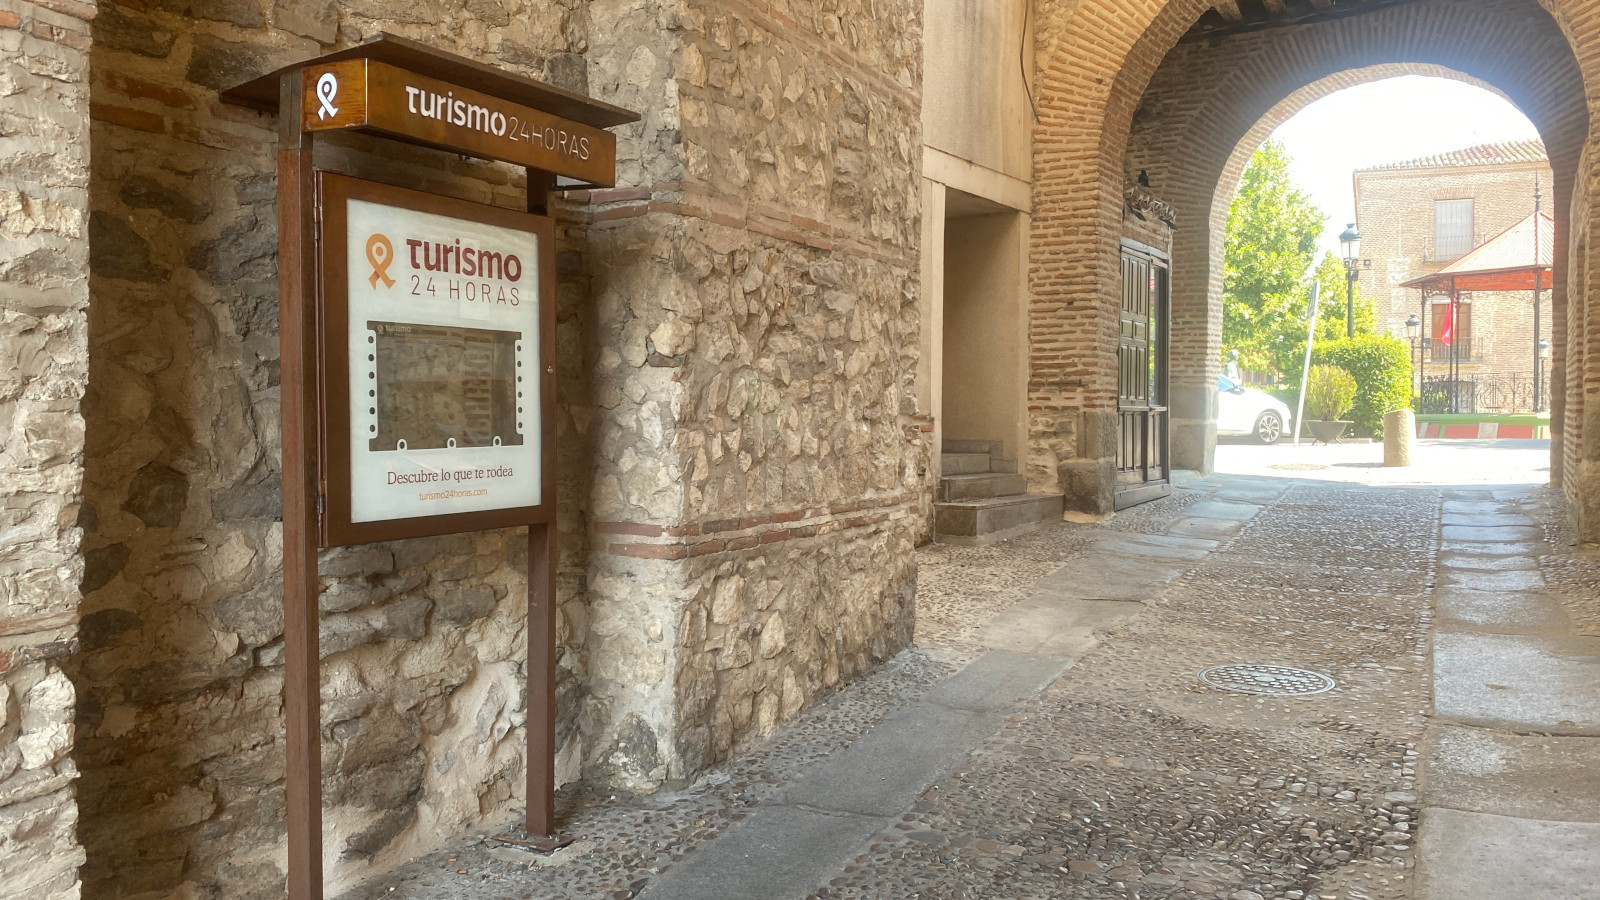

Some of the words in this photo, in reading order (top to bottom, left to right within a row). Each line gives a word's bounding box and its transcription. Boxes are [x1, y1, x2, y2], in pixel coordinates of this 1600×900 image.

[406, 238, 522, 282] turismo
[411, 274, 436, 297] 24
[449, 279, 520, 307] HORAS
[385, 324, 412, 333] turismo
[387, 470, 439, 485] Descubre
[441, 468, 451, 481] lo
[453, 470, 473, 483] que
[474, 468, 484, 479] te
[486, 465, 513, 478] rodea
[419, 488, 488, 500] turismo24horas.com
